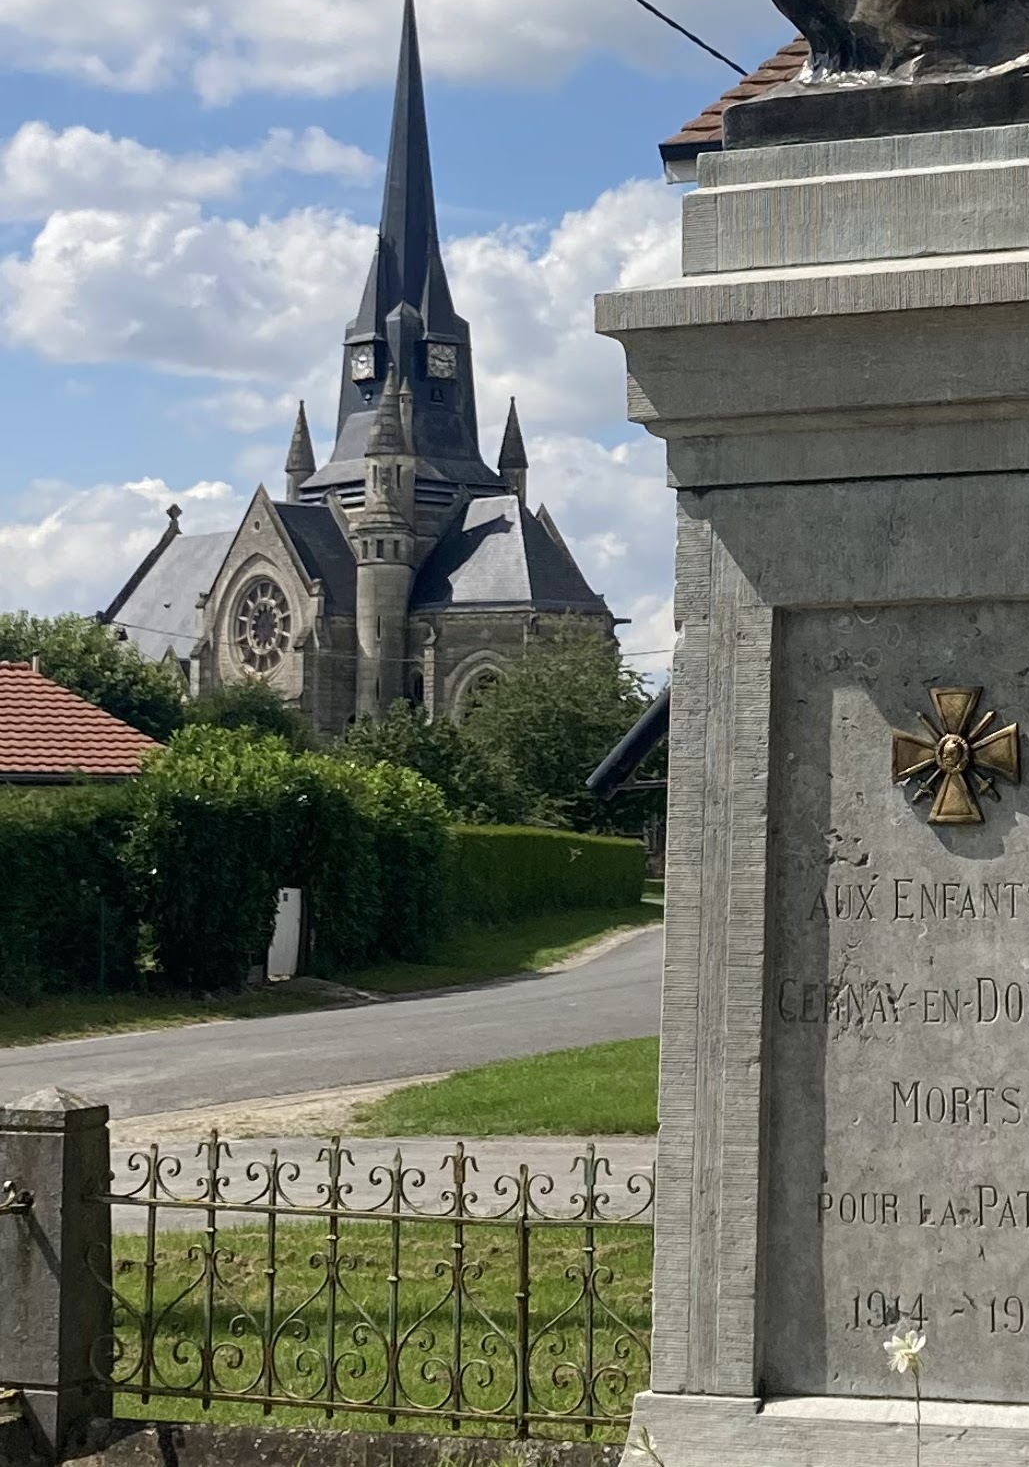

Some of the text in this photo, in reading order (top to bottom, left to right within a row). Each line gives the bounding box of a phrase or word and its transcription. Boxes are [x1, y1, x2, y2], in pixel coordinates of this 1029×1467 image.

[810, 882, 877, 922] AUX
[891, 1080, 1022, 1125] MORTS
[816, 1191, 899, 1227] POUR
[918, 1192, 958, 1228] LA
[852, 1289, 928, 1331] 1914
